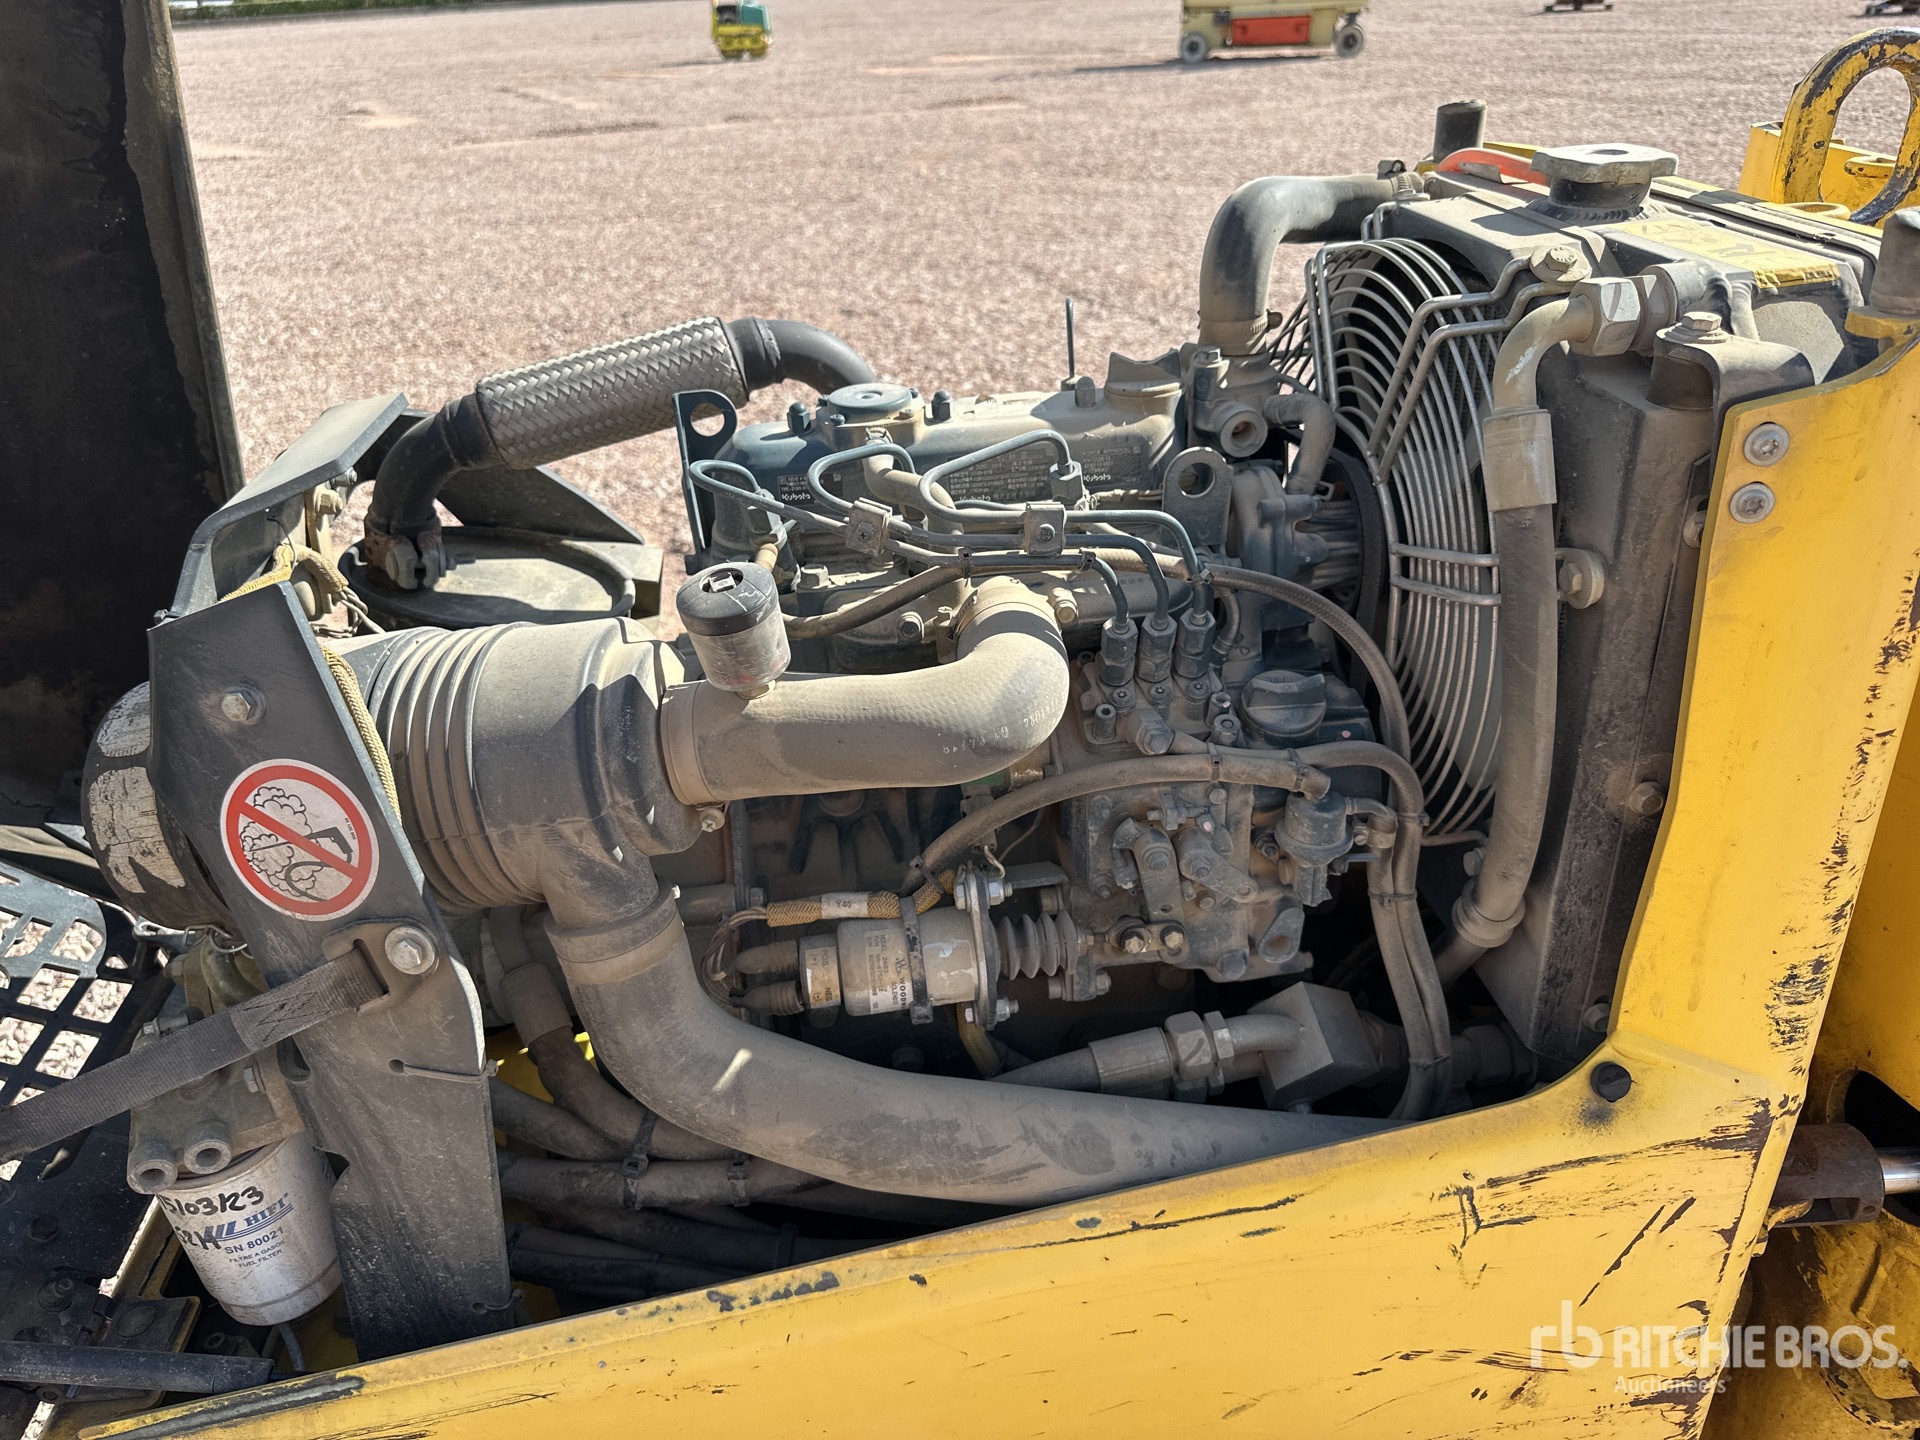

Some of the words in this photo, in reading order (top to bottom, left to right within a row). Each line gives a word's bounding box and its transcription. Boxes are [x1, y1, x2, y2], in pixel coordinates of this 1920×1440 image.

[1083, 473, 1111, 482] Kubota
[781, 491, 811, 501] Kubota
[244, 1197, 287, 1227] HIFI
[224, 1242, 244, 1255] SN
[247, 1226, 285, 1250] 80021
[228, 1253, 254, 1264] FILTRE
[238, 1259, 257, 1269] FUEL
[257, 1248, 284, 1264] FILTER
